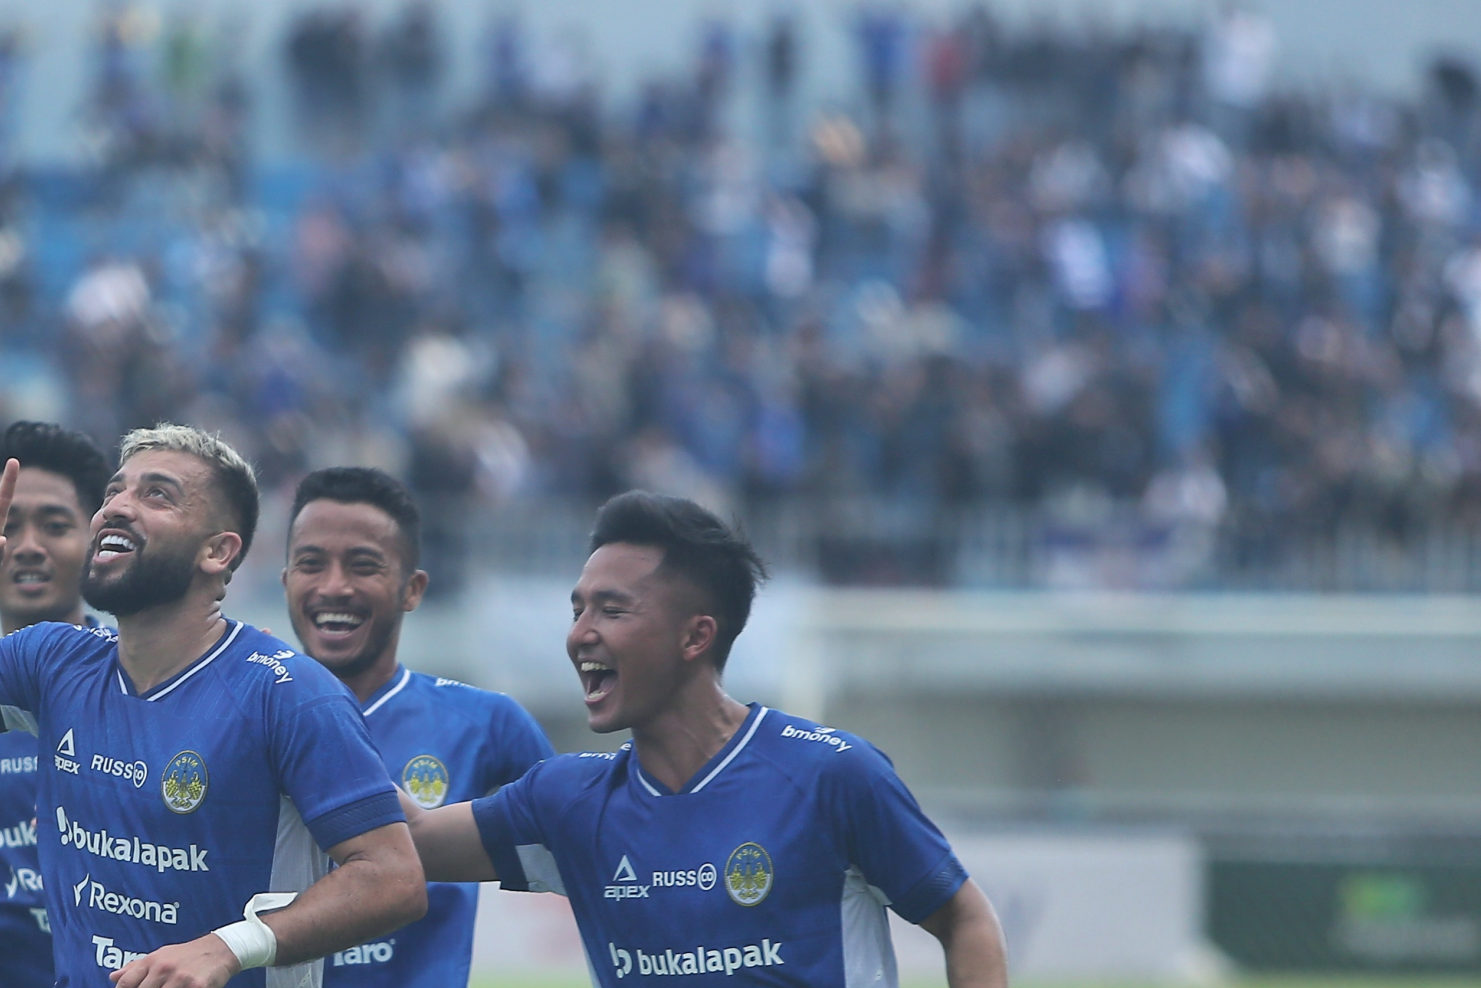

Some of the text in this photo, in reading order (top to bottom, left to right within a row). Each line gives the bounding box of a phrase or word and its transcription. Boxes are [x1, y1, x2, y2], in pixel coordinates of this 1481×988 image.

[246, 651, 294, 684] bmoney
[781, 725, 853, 752] bmoney
[72, 820, 210, 873] bukalapak
[89, 880, 181, 924] Rexona
[603, 885, 652, 902] apex
[637, 938, 785, 976] bukalapak
